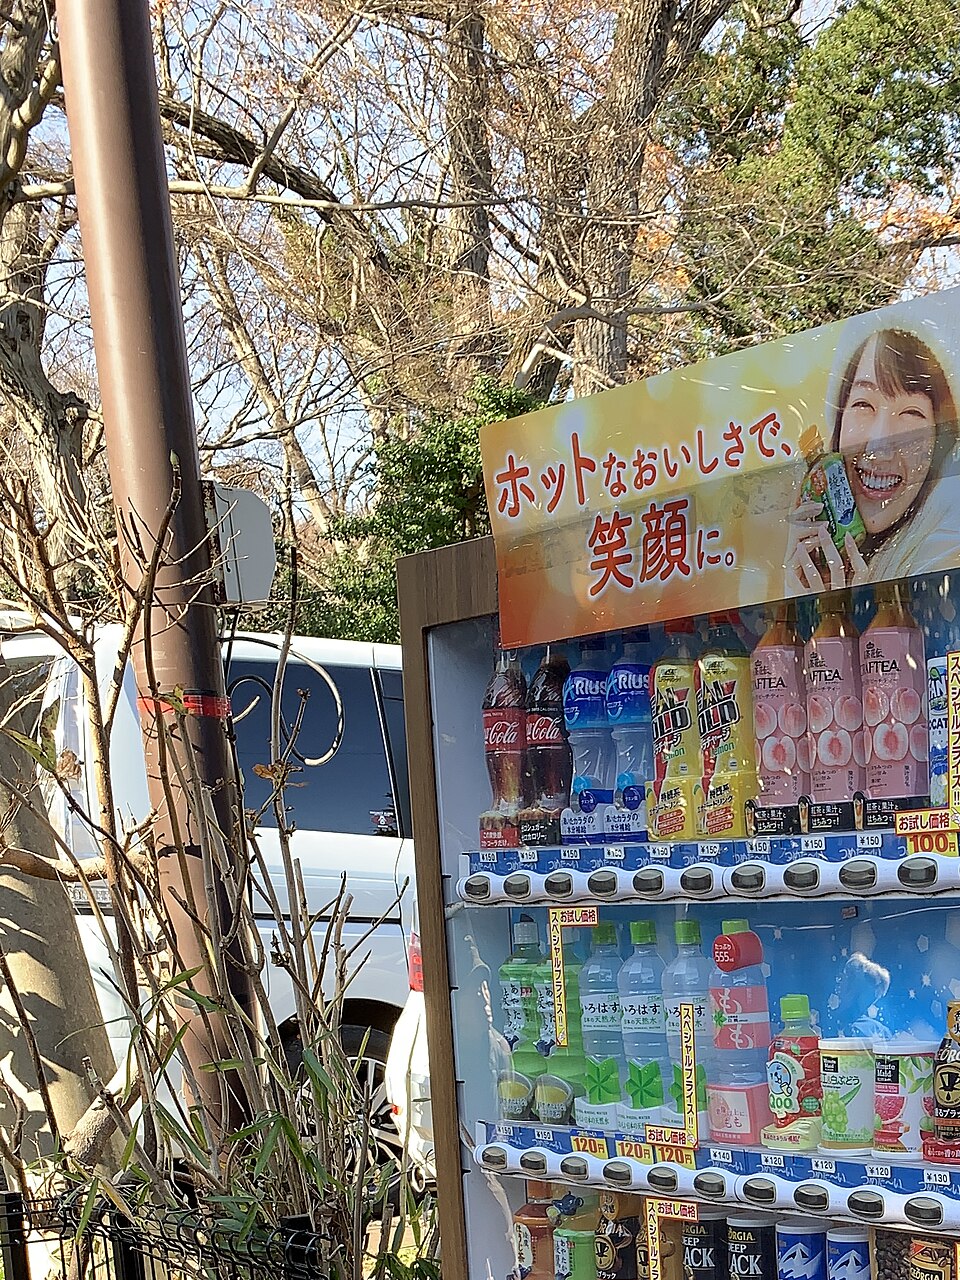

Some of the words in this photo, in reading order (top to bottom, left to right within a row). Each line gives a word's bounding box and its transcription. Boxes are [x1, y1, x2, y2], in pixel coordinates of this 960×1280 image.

[496, 412, 793, 518] ホットなおいしさで、
[588, 499, 736, 598] 笑顔に。
[898, 811, 950, 830] お試し価格
[804, 840, 823, 849] ¥150
[860, 837, 880, 846] ¥150
[909, 834, 956, 853] 100円
[562, 850, 578, 858] ¥150
[560, 910, 596, 923] お試し価格
[647, 1129, 686, 1145] お試し価格
[573, 1138, 605, 1153] 120円
[618, 1141, 651, 1159] 120円
[658, 1146, 692, 1165] 120円
[712, 1150, 731, 1161] ¥140
[763, 1156, 783, 1166] ¥120
[814, 1160, 833, 1170] ¥120
[869, 1167, 889, 1177] ¥120
[926, 1172, 948, 1184] ¥130
[657, 1202, 696, 1218] お試し価格
